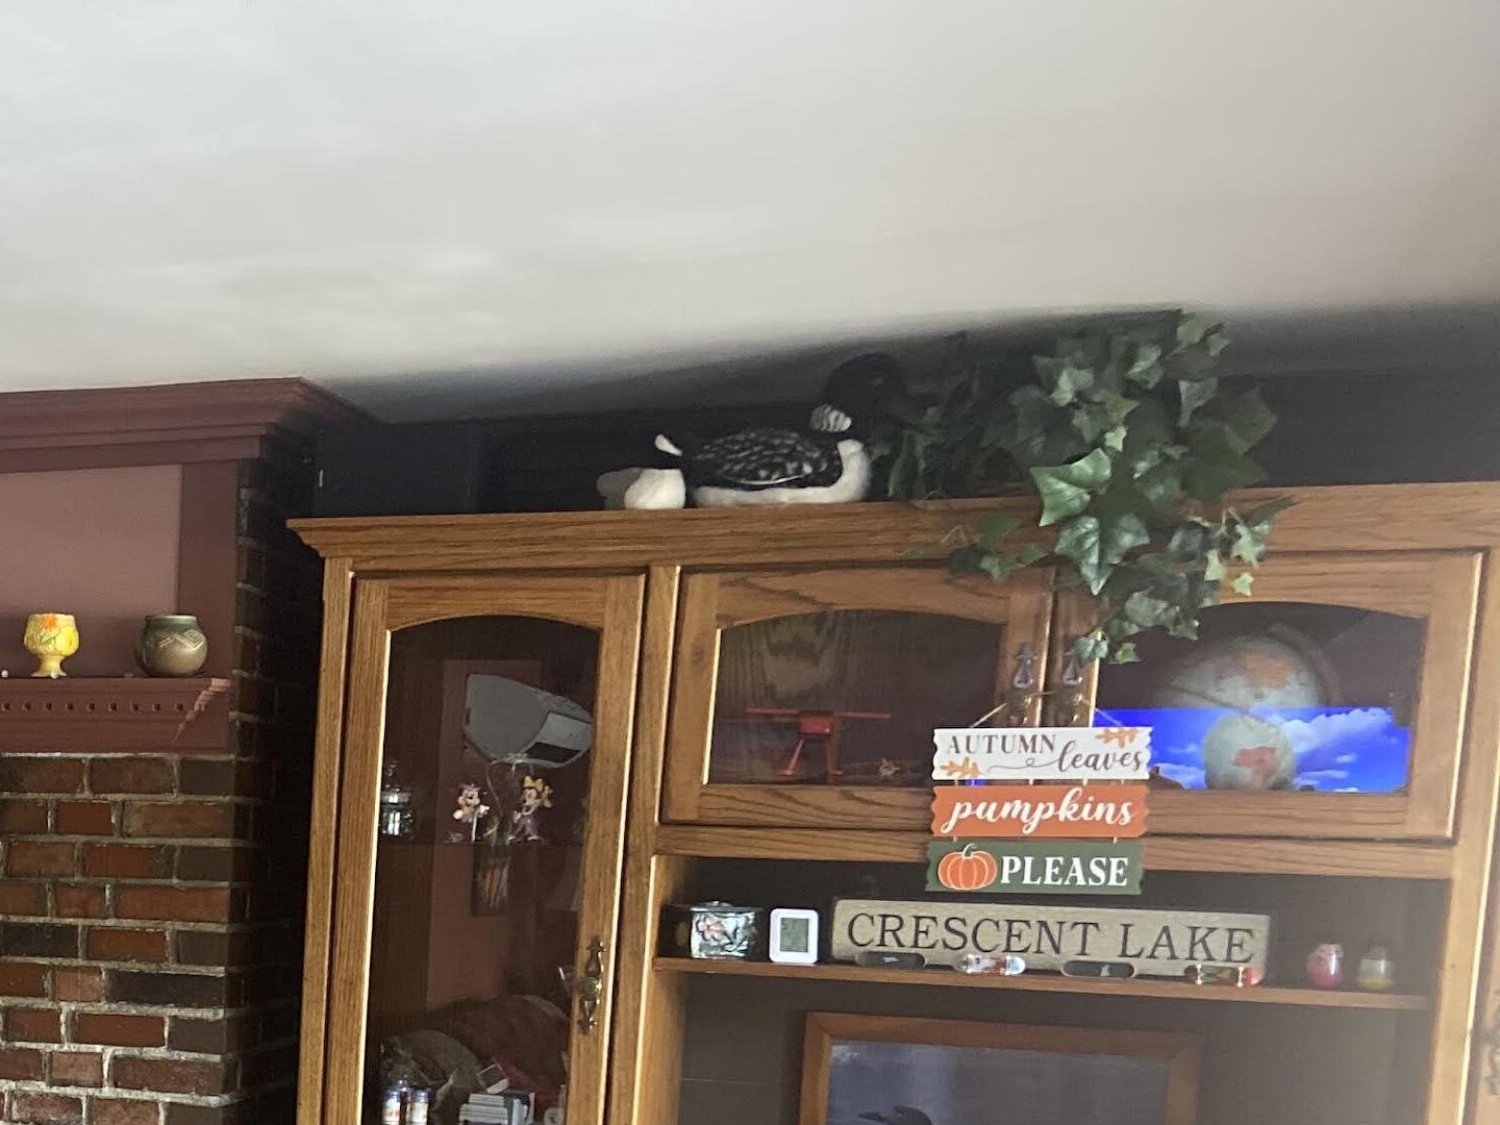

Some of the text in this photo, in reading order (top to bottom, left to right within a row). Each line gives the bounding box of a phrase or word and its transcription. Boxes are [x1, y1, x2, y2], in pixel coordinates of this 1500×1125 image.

[947, 733, 1056, 755] AUTUMN
[1058, 739, 1143, 772] leaves
[940, 787, 1134, 834] pumpkins
[1000, 856, 1129, 887] PLEASE
[846, 912, 1100, 956] CRESCENT
[1118, 923, 1256, 964] LAKE
